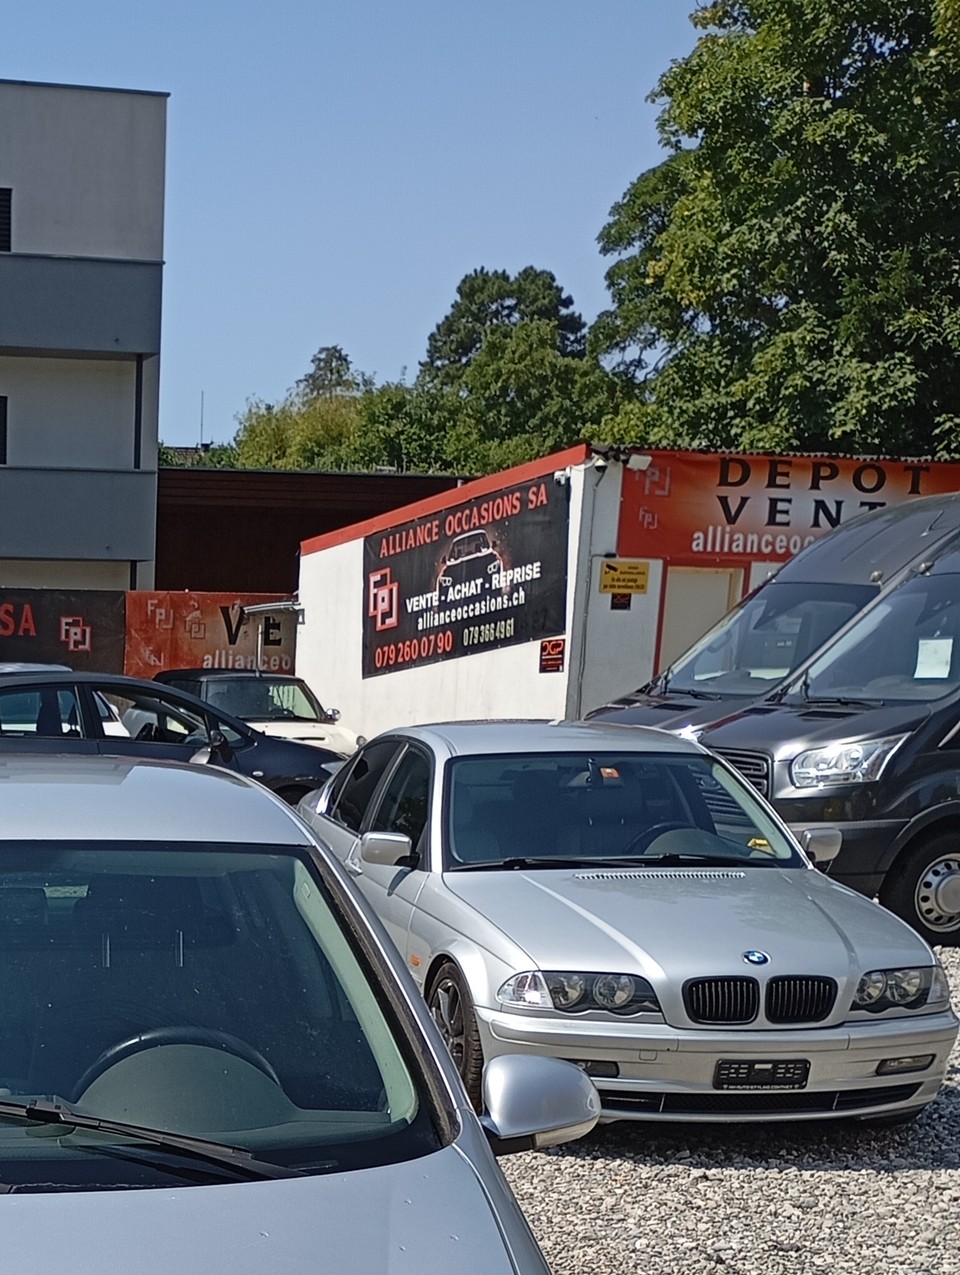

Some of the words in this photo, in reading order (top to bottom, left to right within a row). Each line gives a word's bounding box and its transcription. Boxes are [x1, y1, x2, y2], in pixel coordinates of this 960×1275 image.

[717, 457, 930, 495] DEPOT
[380, 520, 440, 559] ALLIANCE
[445, 491, 521, 536] OCCASIONS
[528, 483, 548, 509] SA
[406, 591, 439, 613] VENTE
[447, 578, 483, 602] ACHAT
[492, 561, 541, 590] REPRISE
[418, 586, 525, 631] allianceoccasions.ch
